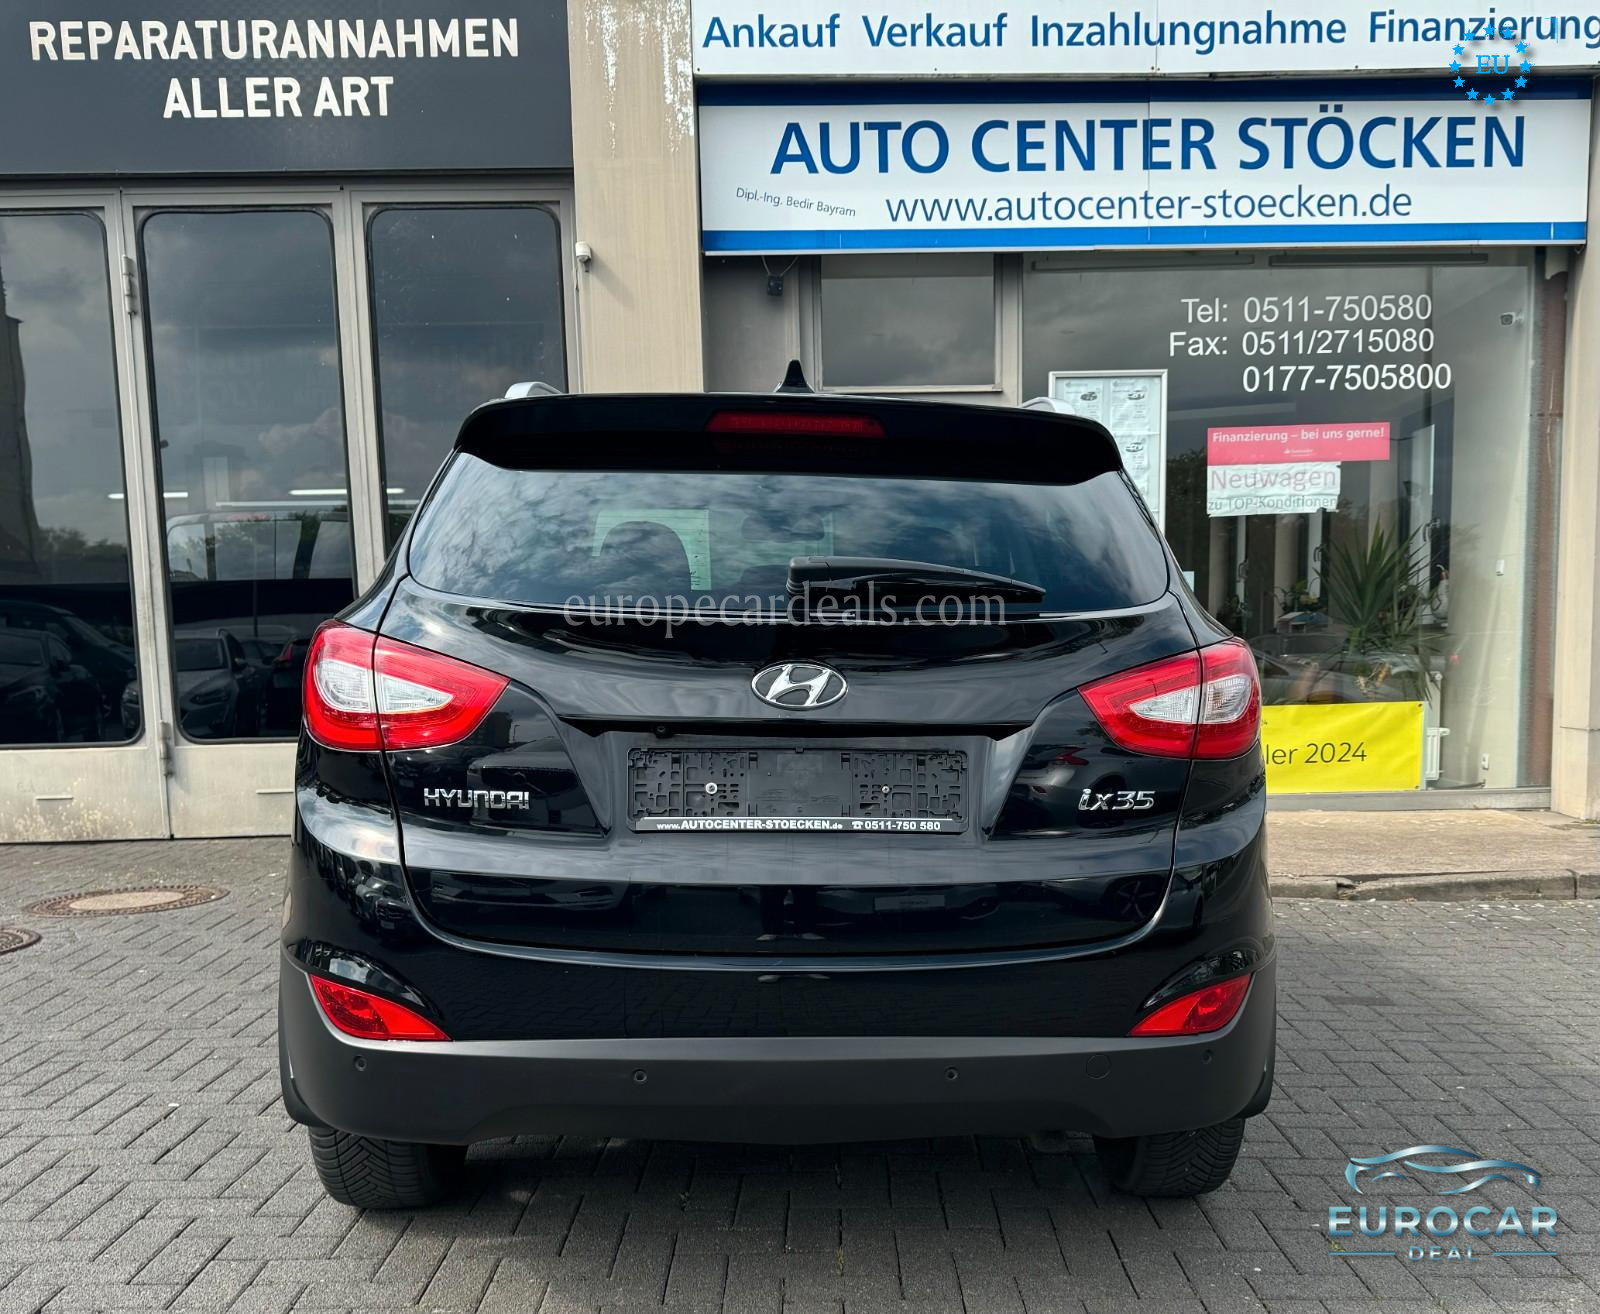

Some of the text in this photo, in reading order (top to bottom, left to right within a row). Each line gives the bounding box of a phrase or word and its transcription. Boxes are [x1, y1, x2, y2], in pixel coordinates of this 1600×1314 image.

[29, 18, 519, 61] REPARATURANNAHMEN
[702, 8, 1600, 55] Ankauf Verkauf Inzahlungnahme Finanzierung
[163, 76, 394, 119] ALLER ART
[770, 103, 1525, 175] AUTO CENTER STÖCKEN
[736, 187, 856, 217] Dipl.-Ing. Bedir Bayram
[886, 184, 1412, 222] www.autocenter-stoecken.de
[1181, 294, 1432, 323] Tel: 0511-750580
[1169, 328, 1435, 357] Fax: 0511/2715080
[1243, 363, 1452, 392] 0177-7505800
[1212, 432, 1288, 443] Finanzierung
[1301, 428, 1319, 440] bei
[1346, 427, 1384, 440] gerne!
[1211, 470, 1336, 491] Neuwagen
[1208, 501, 1222, 511] zu
[1265, 742, 1367, 765] ler 2024
[423, 788, 530, 809] HYUNDAI
[1078, 788, 1156, 810] ix35
[656, 819, 941, 830] www.AUTOCENTER-STOECKEN.de 0511-750 580
